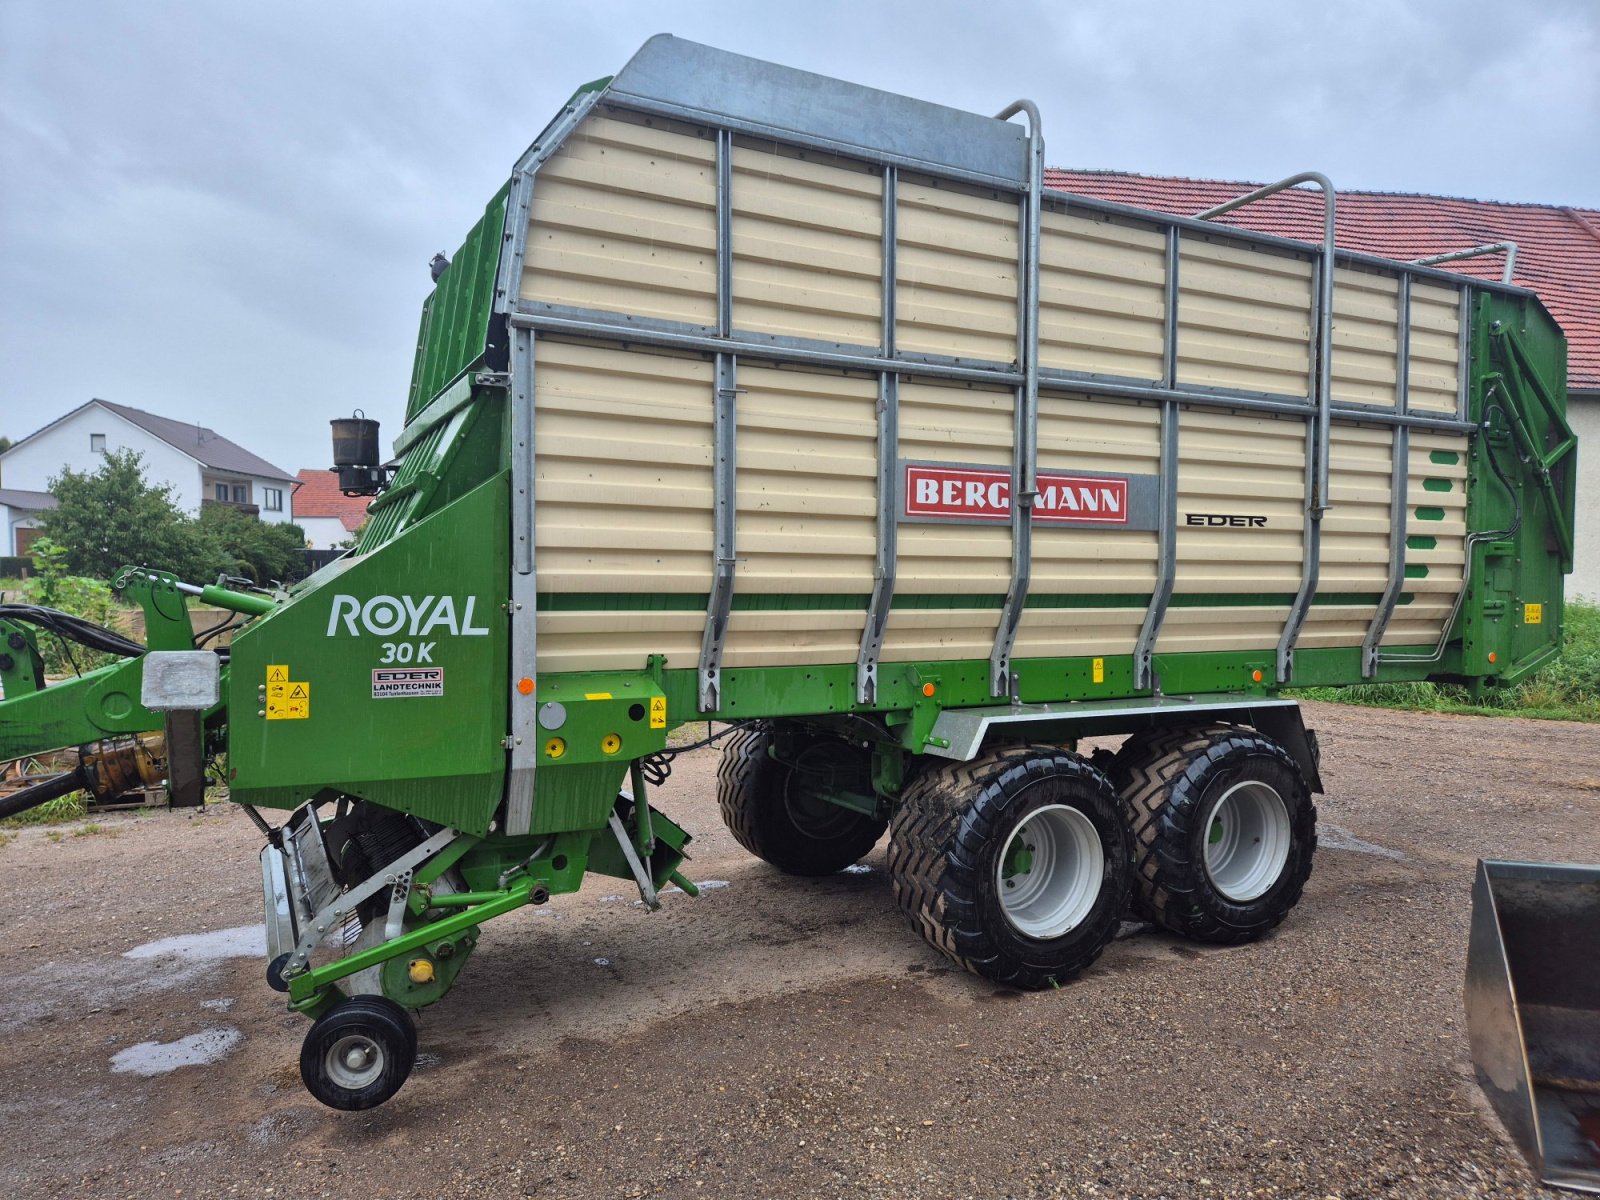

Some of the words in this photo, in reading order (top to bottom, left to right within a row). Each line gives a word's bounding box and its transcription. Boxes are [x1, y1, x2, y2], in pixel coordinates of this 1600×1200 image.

[916, 478, 1120, 513] BERGMANN
[1185, 513, 1268, 528] EDER
[326, 594, 490, 637] ROYAL
[380, 642, 413, 663] 30
[416, 642, 437, 663] K
[377, 671, 440, 681] EDER
[373, 682, 442, 691] LANDTECHNIK
